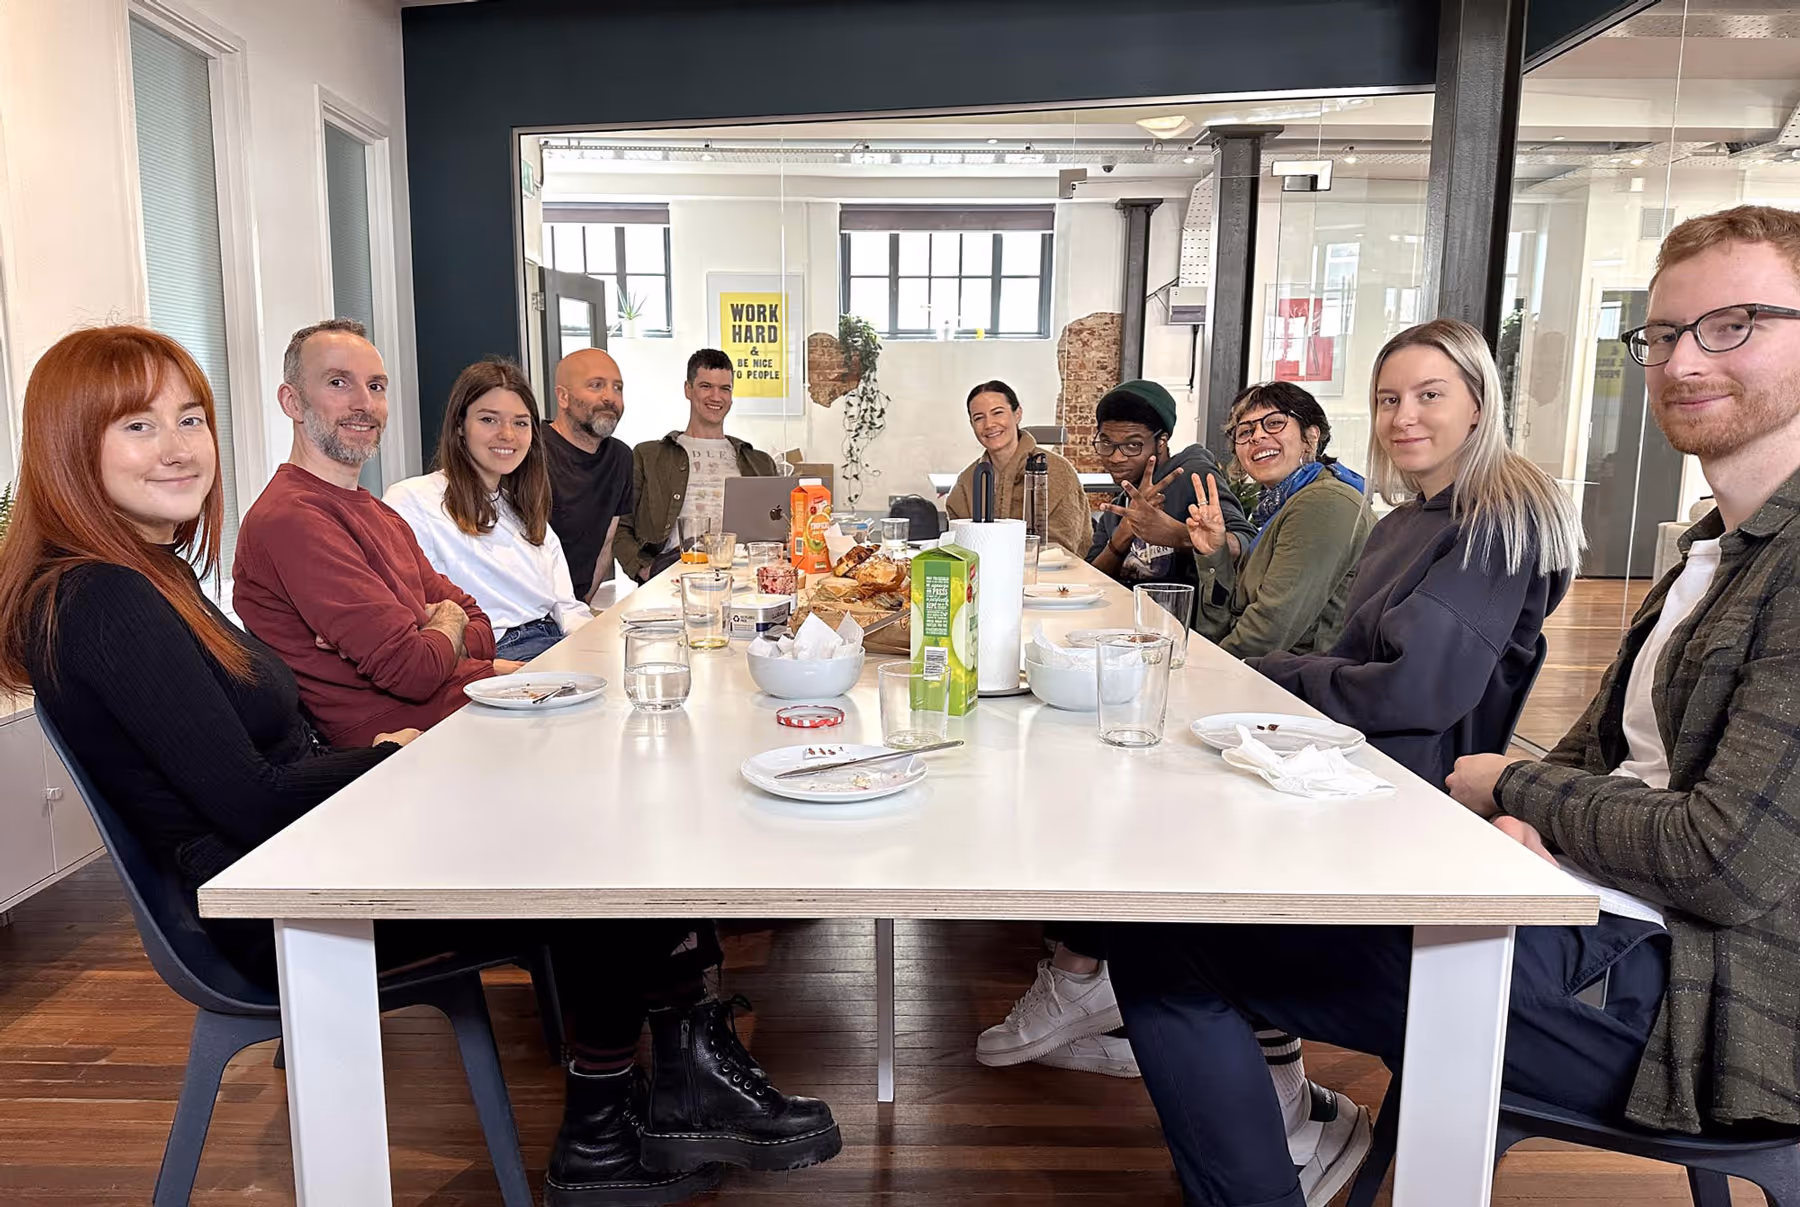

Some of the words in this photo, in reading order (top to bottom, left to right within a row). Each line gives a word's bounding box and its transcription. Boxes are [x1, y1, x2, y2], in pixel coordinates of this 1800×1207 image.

[730, 303, 779, 323] WORK
[732, 325, 778, 343] HARD
[750, 346, 759, 356] &
[737, 359, 748, 368] BE
[753, 359, 773, 368] NICE
[747, 370, 780, 380] PEOPLE
